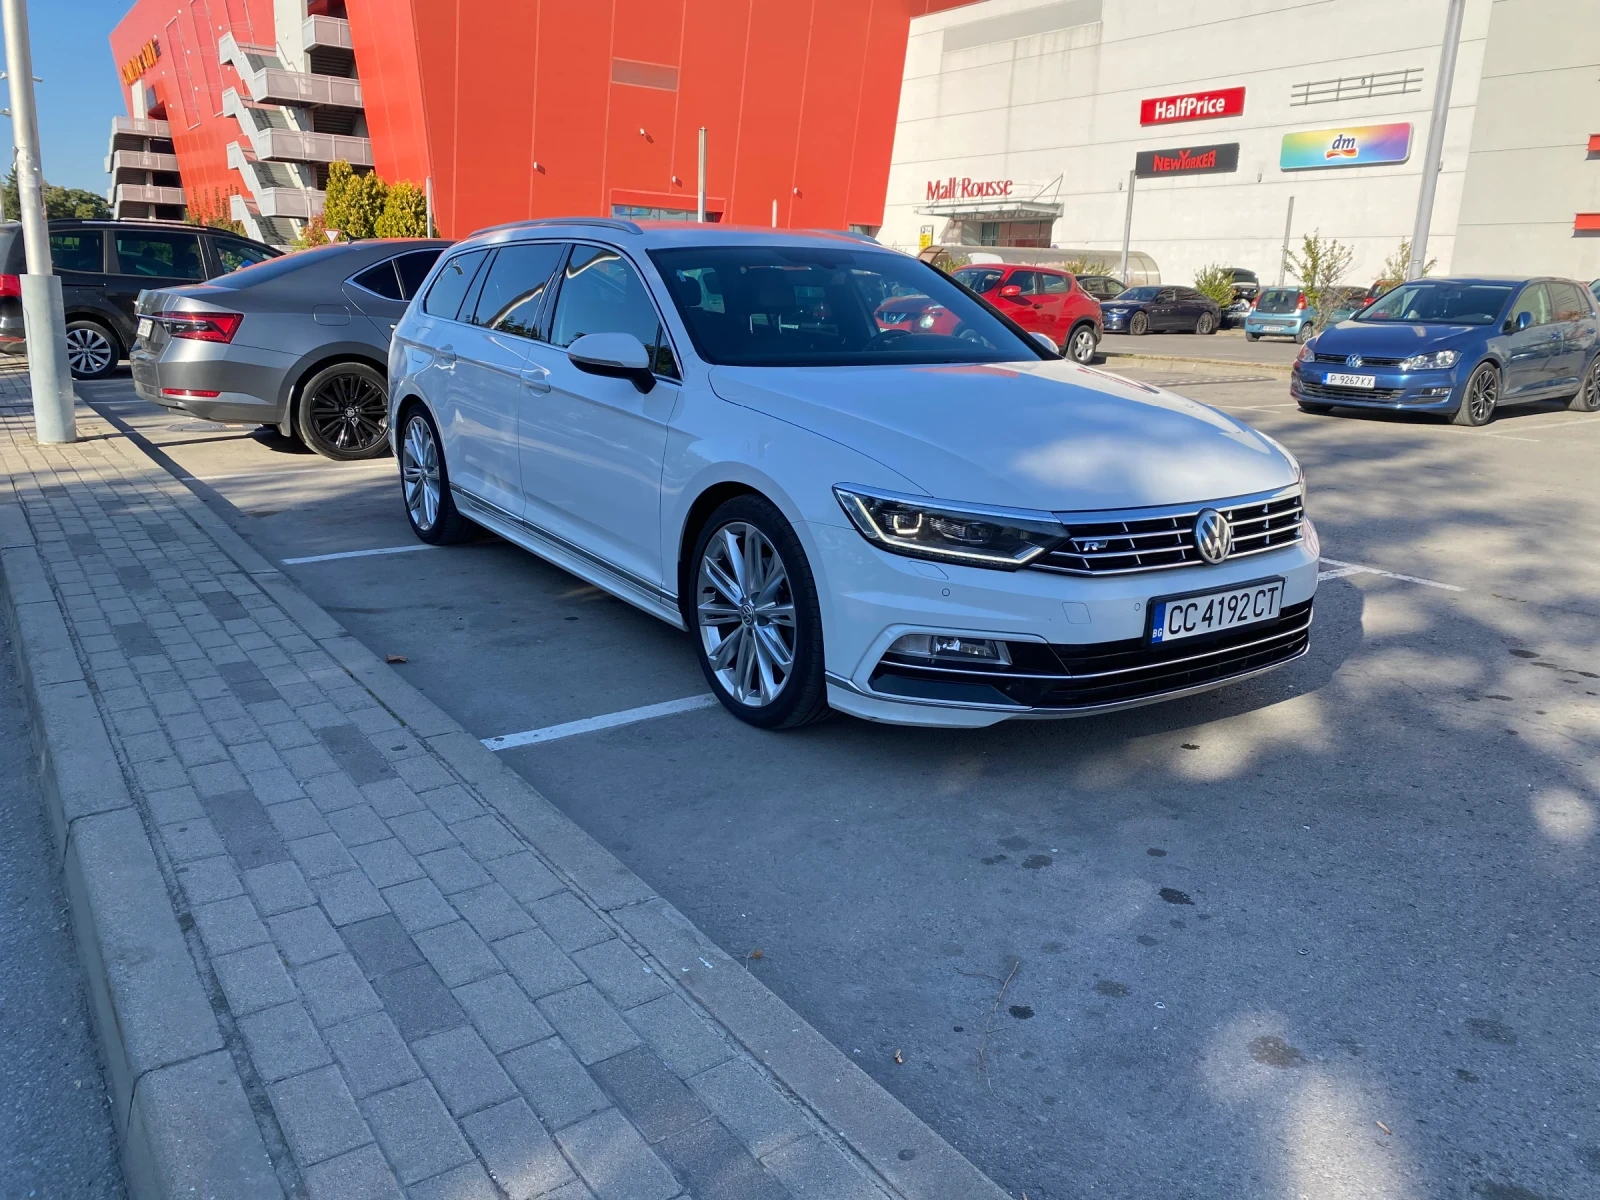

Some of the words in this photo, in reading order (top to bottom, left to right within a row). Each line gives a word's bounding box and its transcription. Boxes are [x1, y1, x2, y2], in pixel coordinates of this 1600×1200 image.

[1154, 96, 1226, 120] HalfPrice
[1332, 133, 1356, 150] dm
[926, 177, 957, 201] Mall
[961, 177, 1014, 198] Rousse
[1152, 628, 1163, 639] BG
